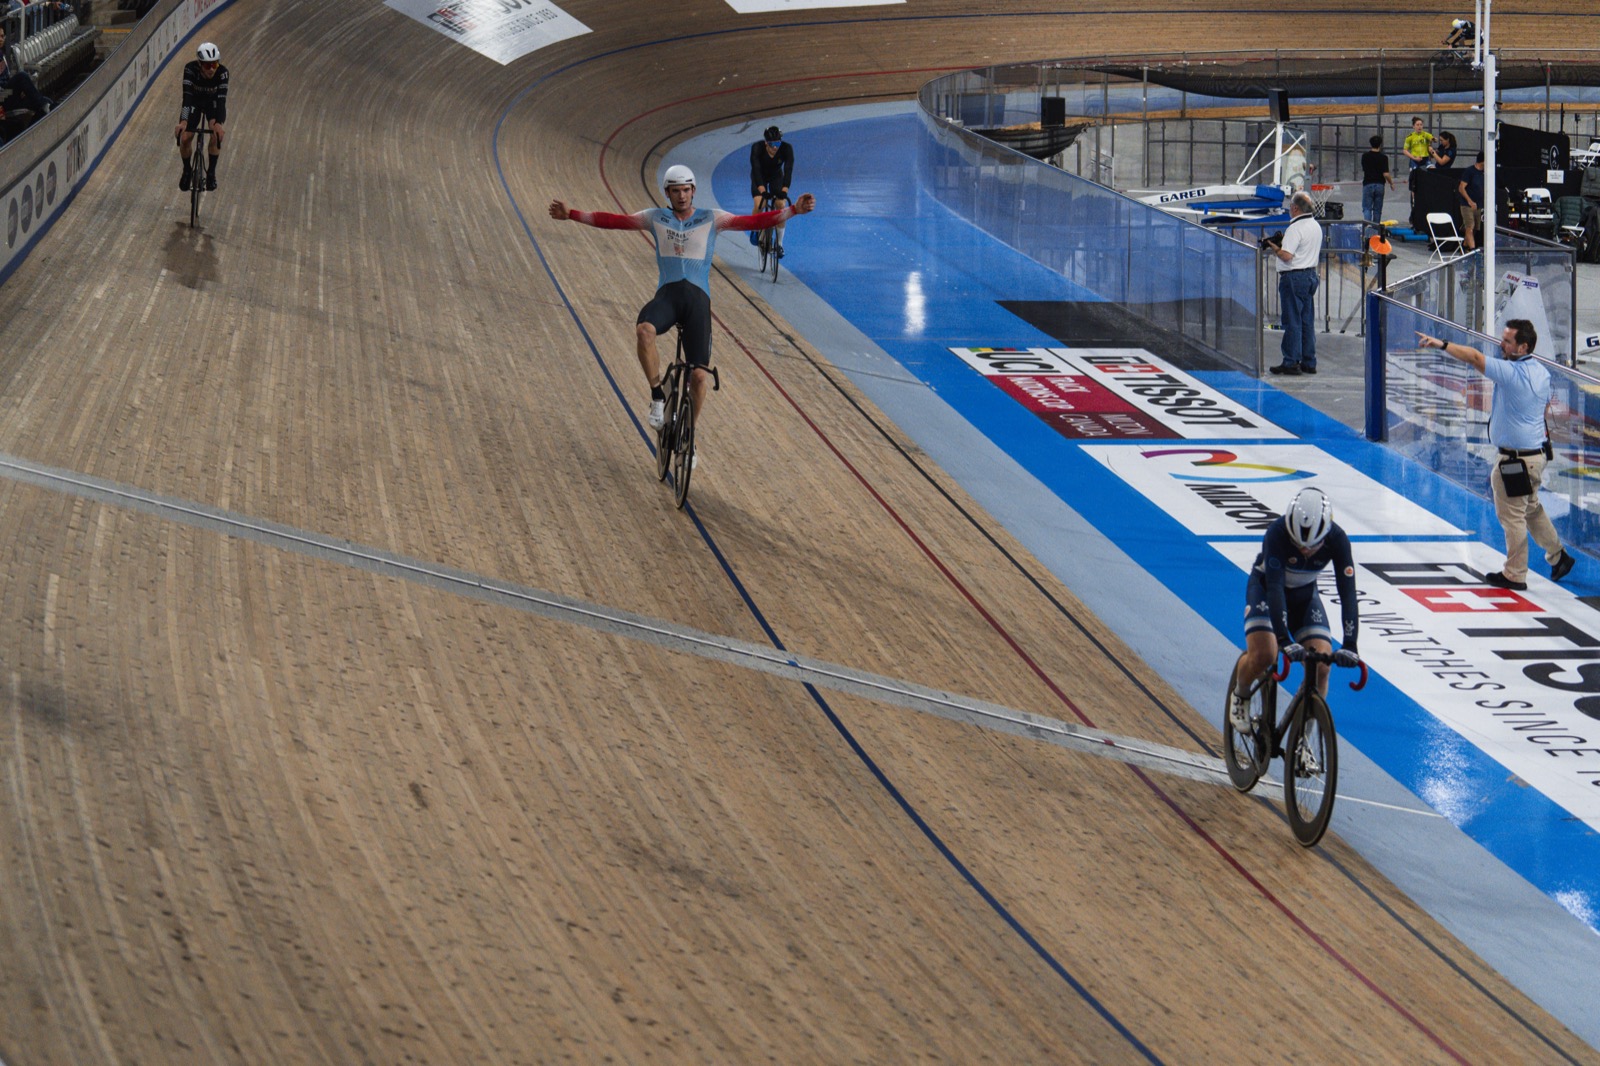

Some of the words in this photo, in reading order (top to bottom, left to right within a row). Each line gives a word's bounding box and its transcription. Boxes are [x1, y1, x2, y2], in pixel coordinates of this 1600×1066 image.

[1160, 188, 1206, 203] GARED
[666, 228, 687, 239] ISRAEL
[975, 351, 1062, 374] UCI
[1006, 376, 1060, 399] NATIONS
[1037, 398, 1075, 410] CUP
[1113, 374, 1259, 429] TISSOT
[1058, 413, 1113, 437] CANADA
[1098, 413, 1154, 436] MILTON
[1184, 483, 1281, 530] MILTON
[1345, 619, 1355, 637] EQC
[1358, 611, 1506, 691] WATCHES
[1474, 699, 1600, 757] SINCE
